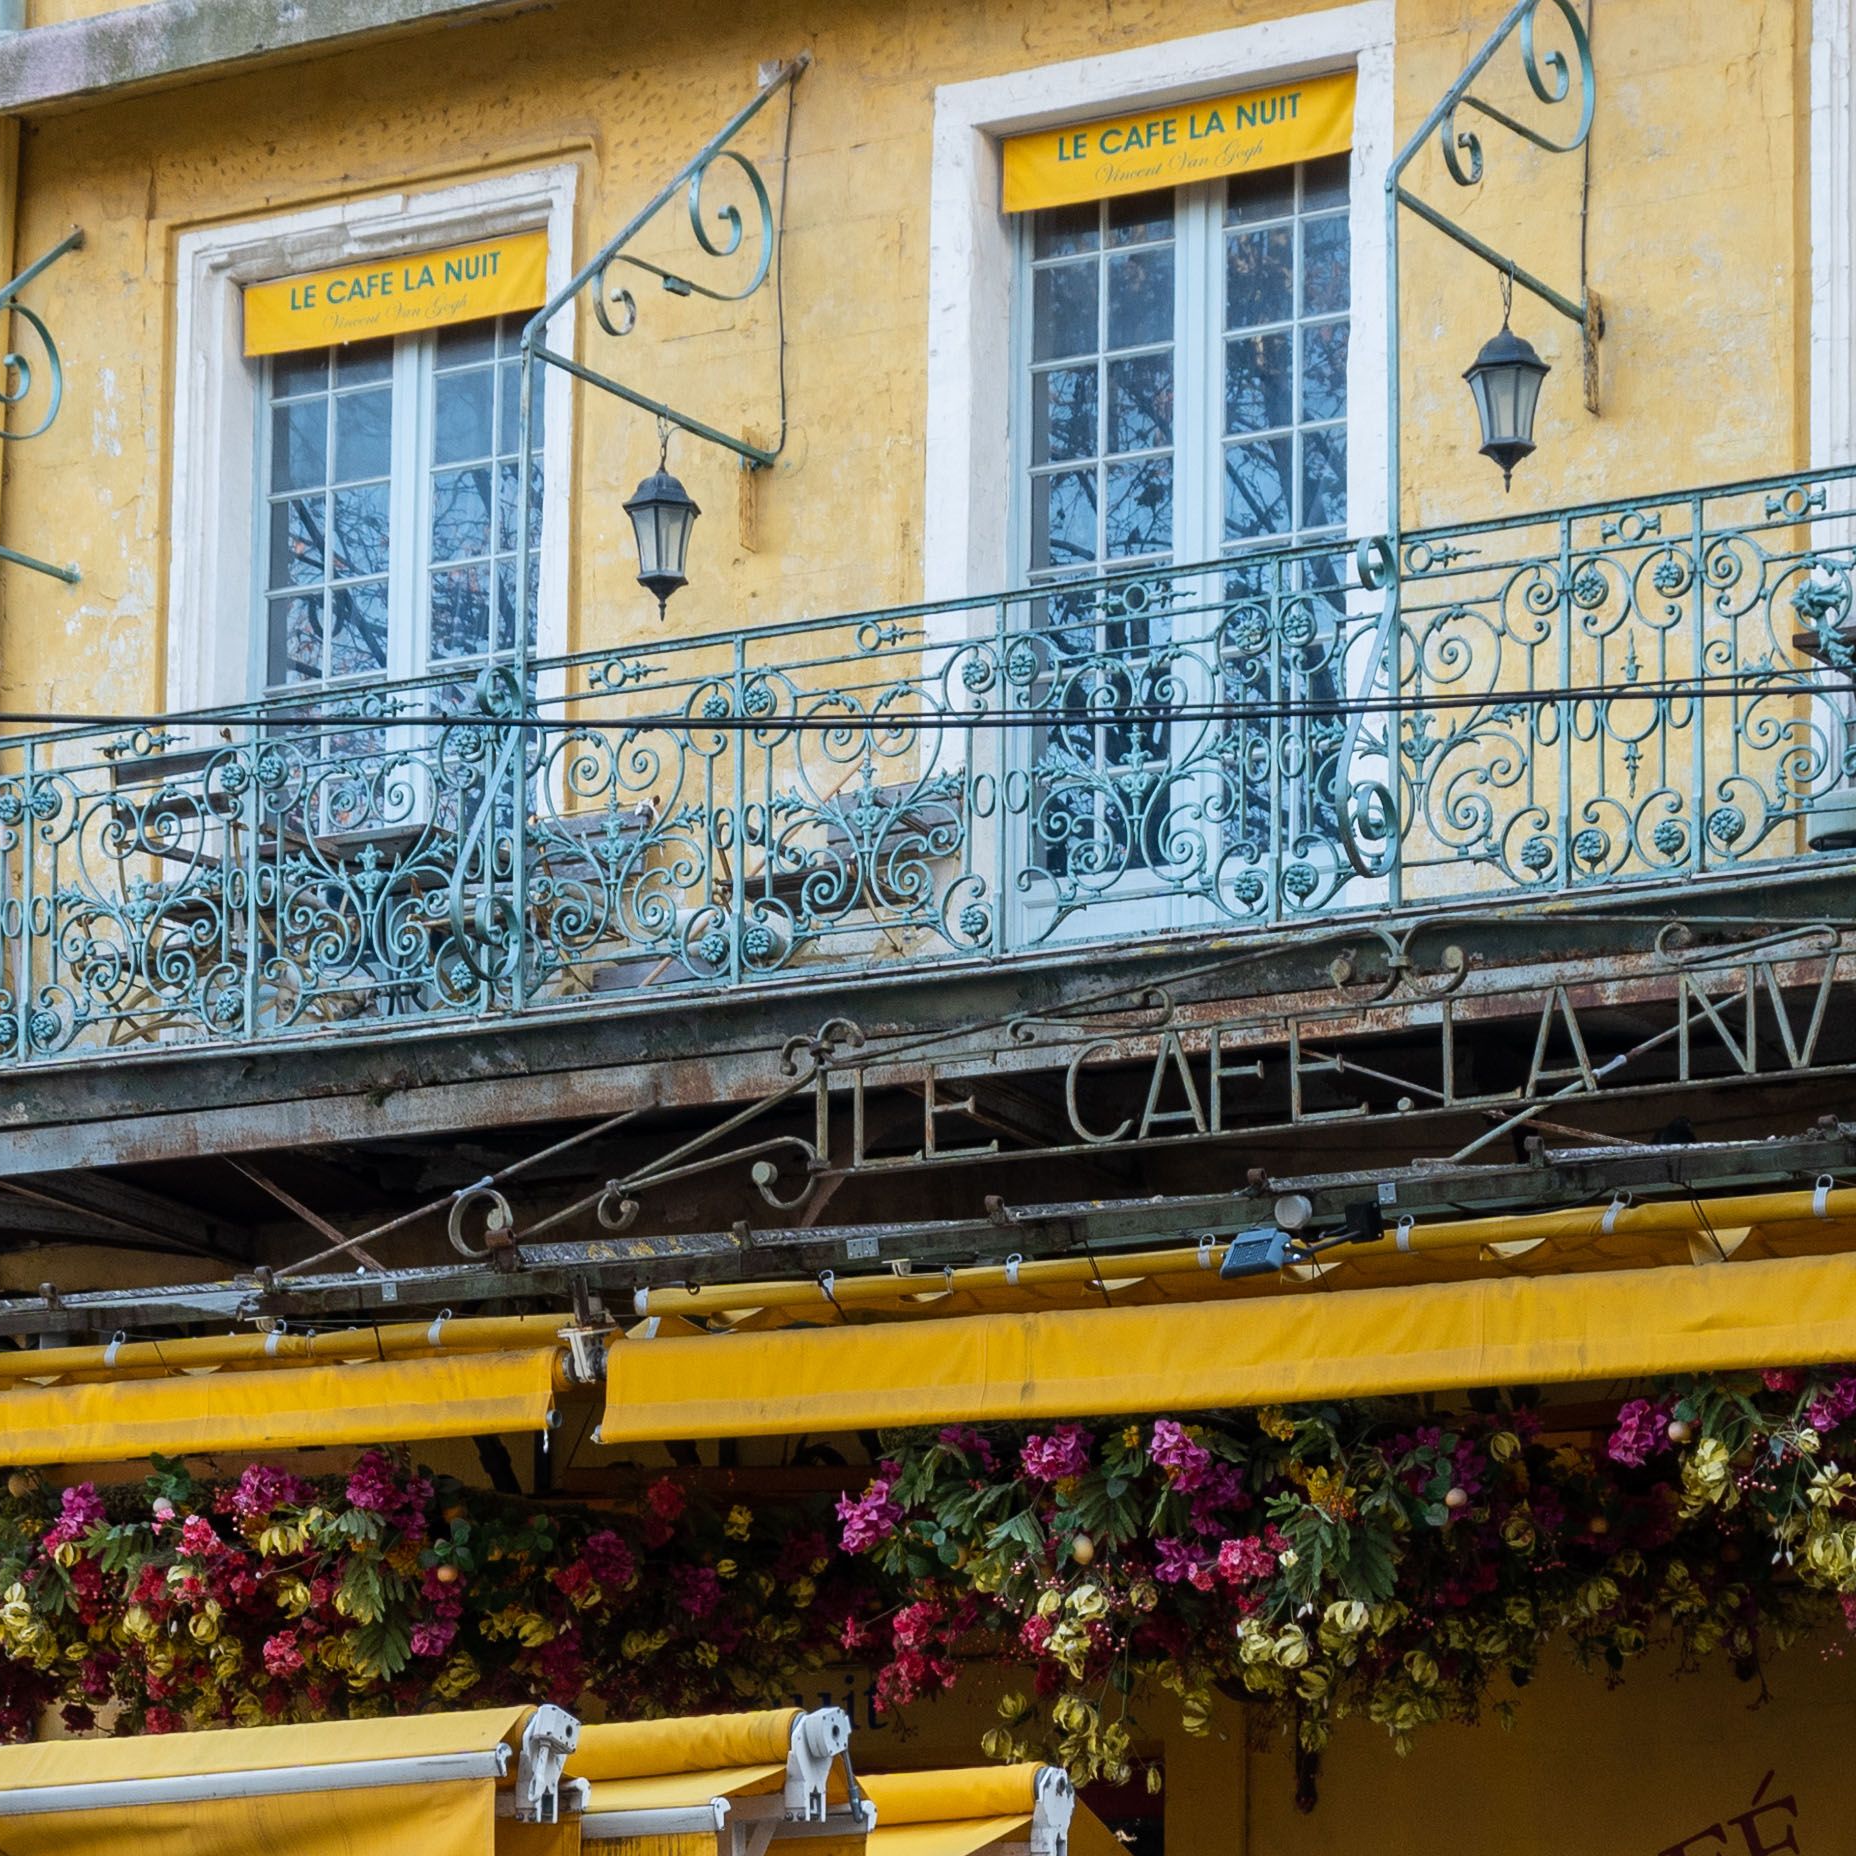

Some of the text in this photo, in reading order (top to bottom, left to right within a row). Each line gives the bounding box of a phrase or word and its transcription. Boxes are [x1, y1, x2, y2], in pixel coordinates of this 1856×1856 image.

[1057, 91, 1302, 162] LE CAFE LA NUIT
[290, 251, 501, 311] LE CAFE LA NUIT
[852, 1048, 999, 1169] LE
[1441, 982, 1598, 1106] LA
